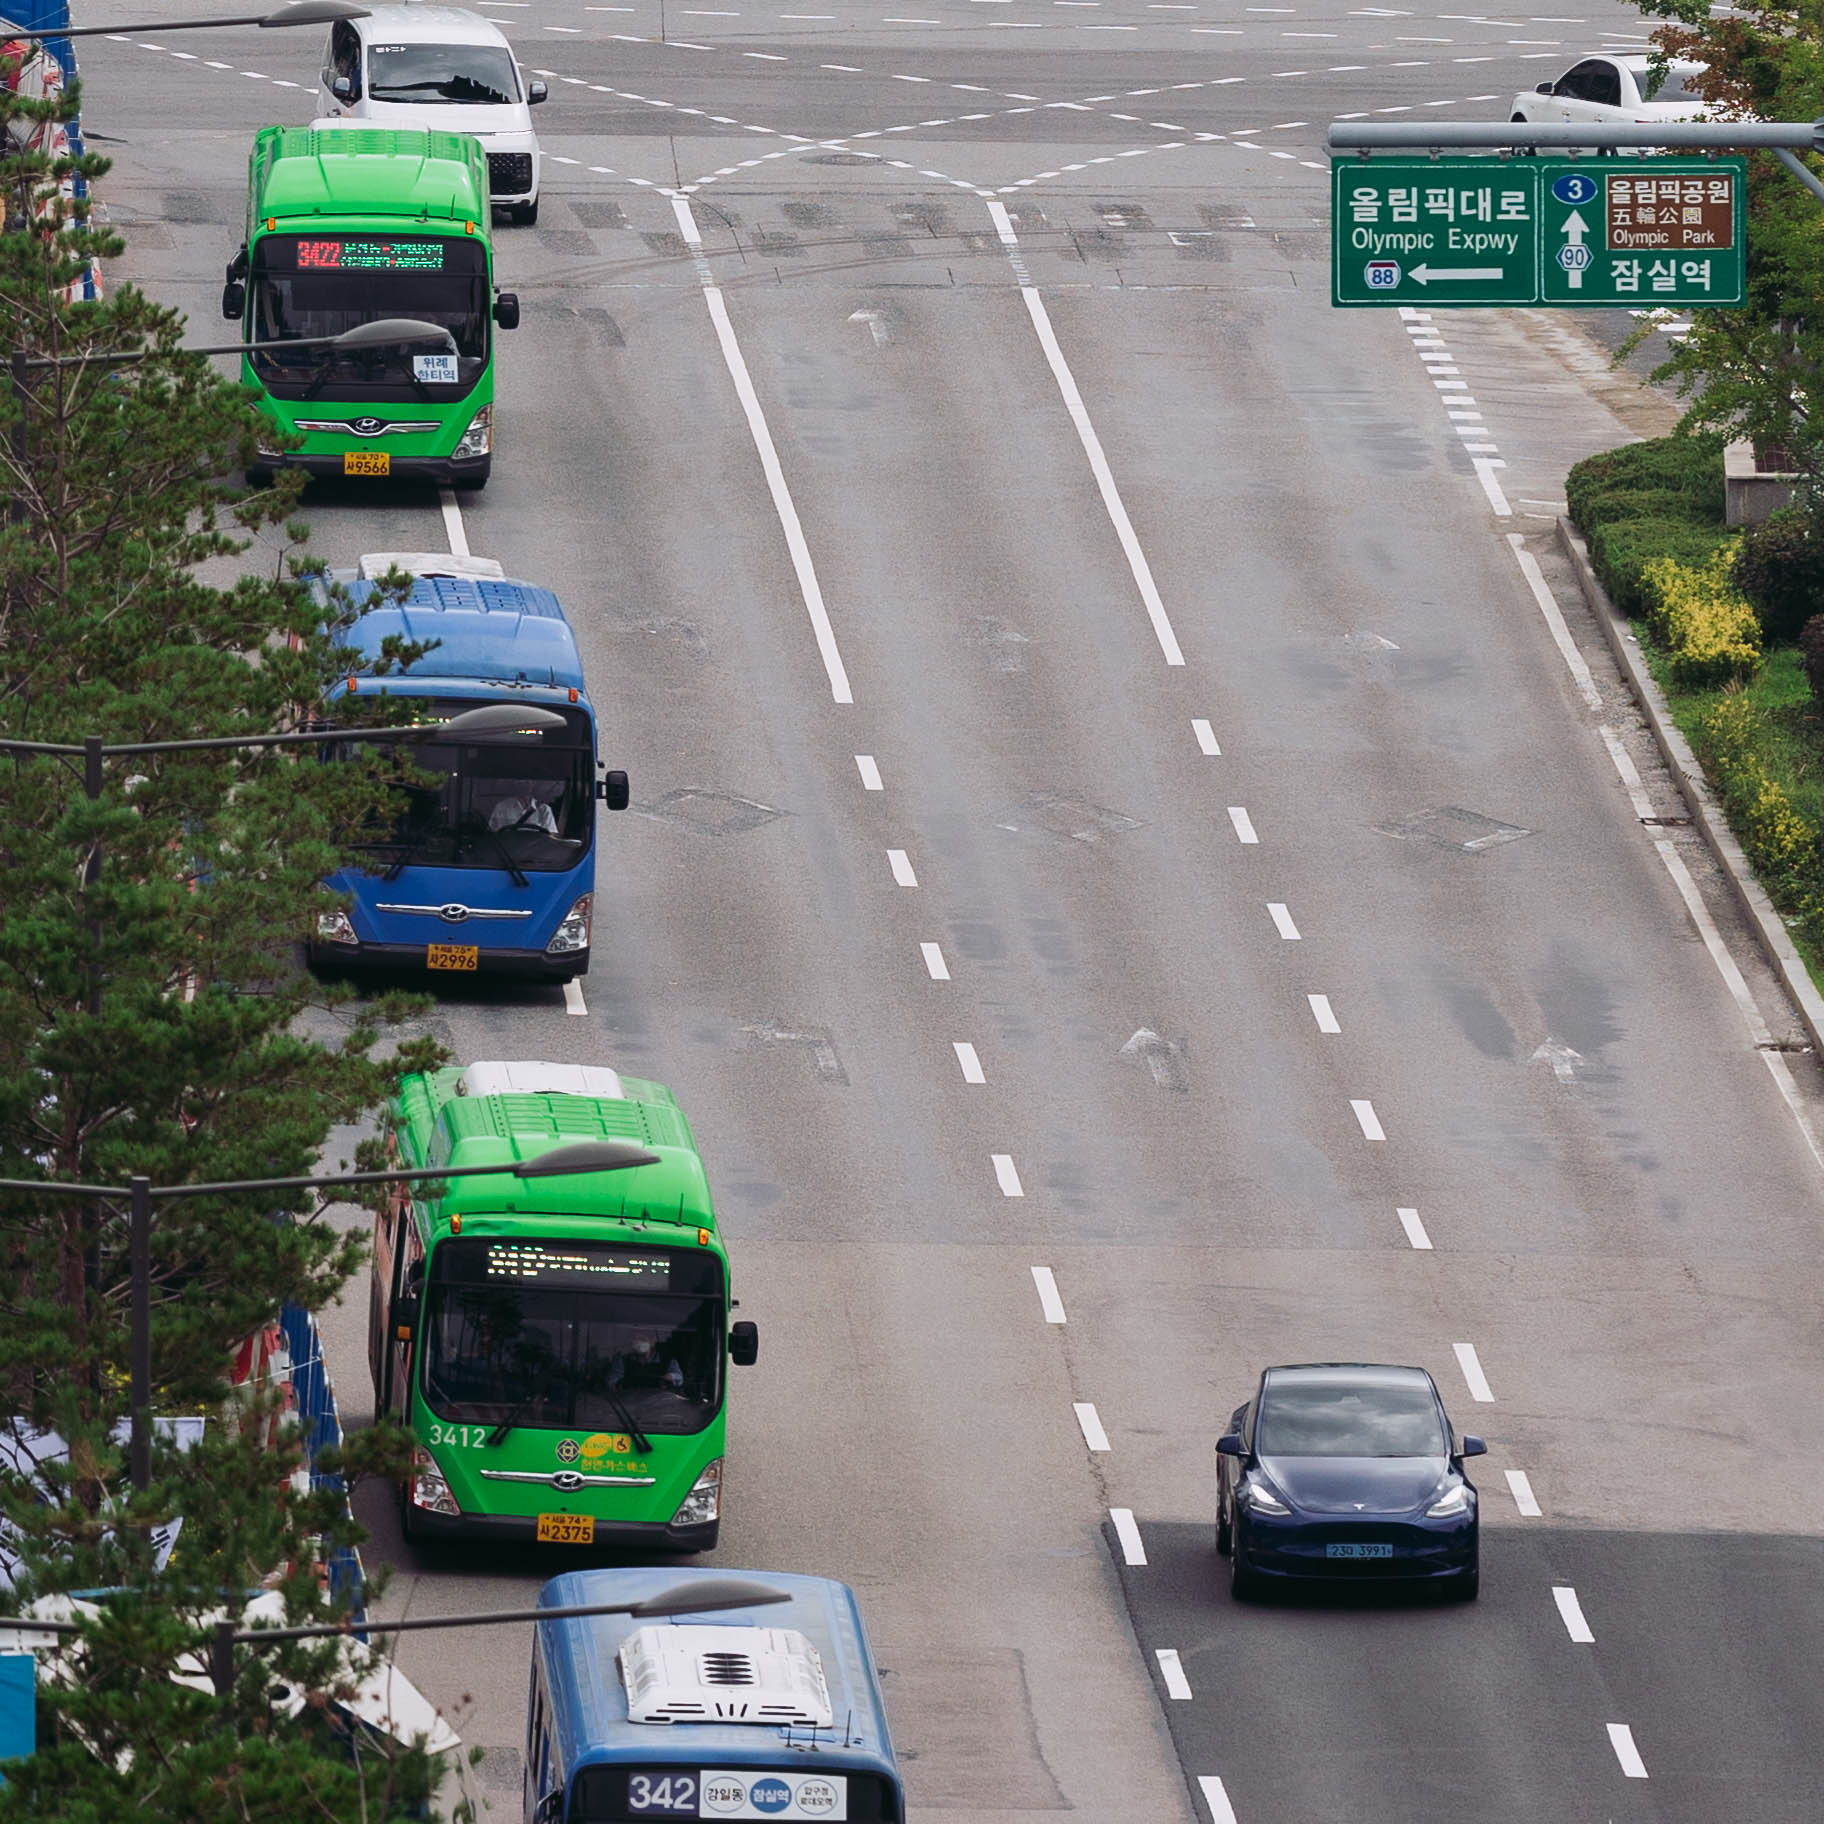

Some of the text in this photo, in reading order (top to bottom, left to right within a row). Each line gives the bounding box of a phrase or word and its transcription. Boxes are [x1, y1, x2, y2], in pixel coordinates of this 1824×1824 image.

[1567, 180, 1583, 200] 3
[1609, 181, 1730, 205] 올림픽공원
[1349, 187, 1531, 223] 올림픽대로
[1352, 228, 1519, 254] Olympic Expwy
[1612, 228, 1716, 246] Olympic Park
[297, 241, 340, 268] 3422
[1563, 247, 1586, 269] 90
[1371, 268, 1394, 286] 88
[1610, 259, 1712, 292] 잠실역
[429, 1424, 487, 1449] 3412
[629, 1775, 696, 1810] 342
[707, 1787, 745, 1802] 강일동
[753, 1788, 790, 1803] 잠실역
